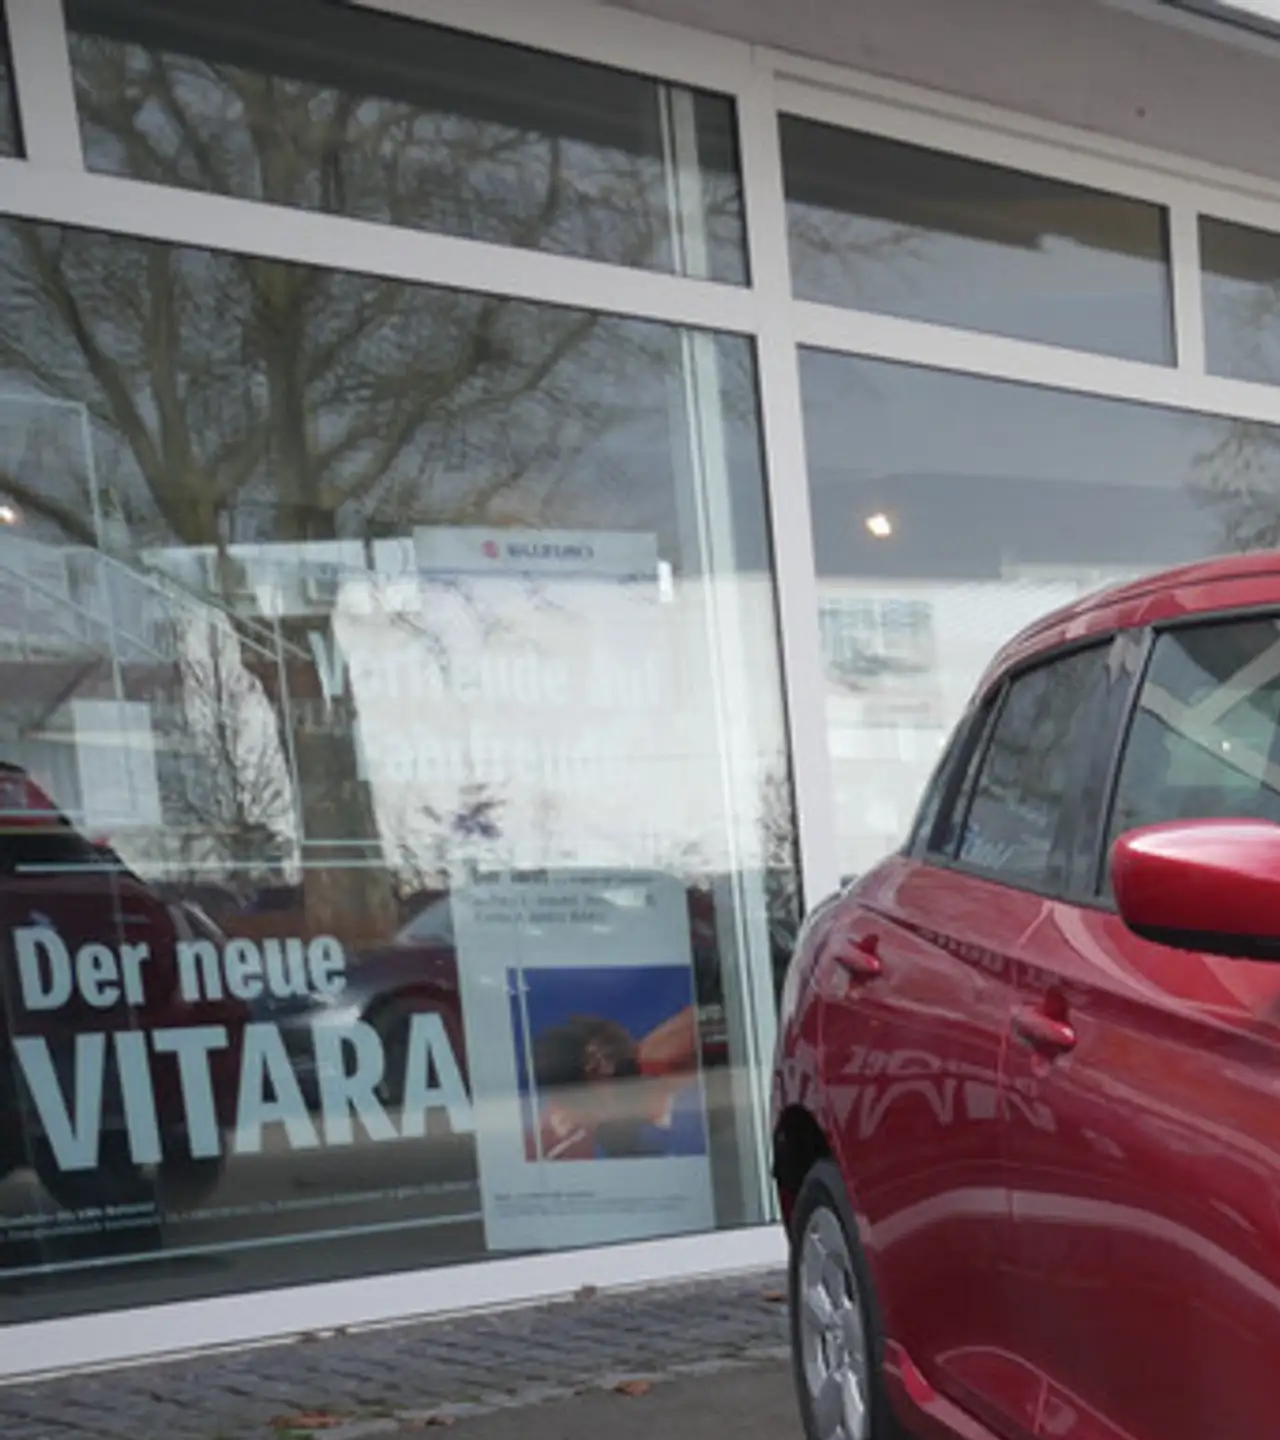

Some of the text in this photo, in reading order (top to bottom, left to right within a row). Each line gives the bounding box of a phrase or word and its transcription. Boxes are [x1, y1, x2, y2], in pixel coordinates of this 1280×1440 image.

[13, 926, 347, 1011] Der neue
[13, 1011, 476, 1172] VITARA
